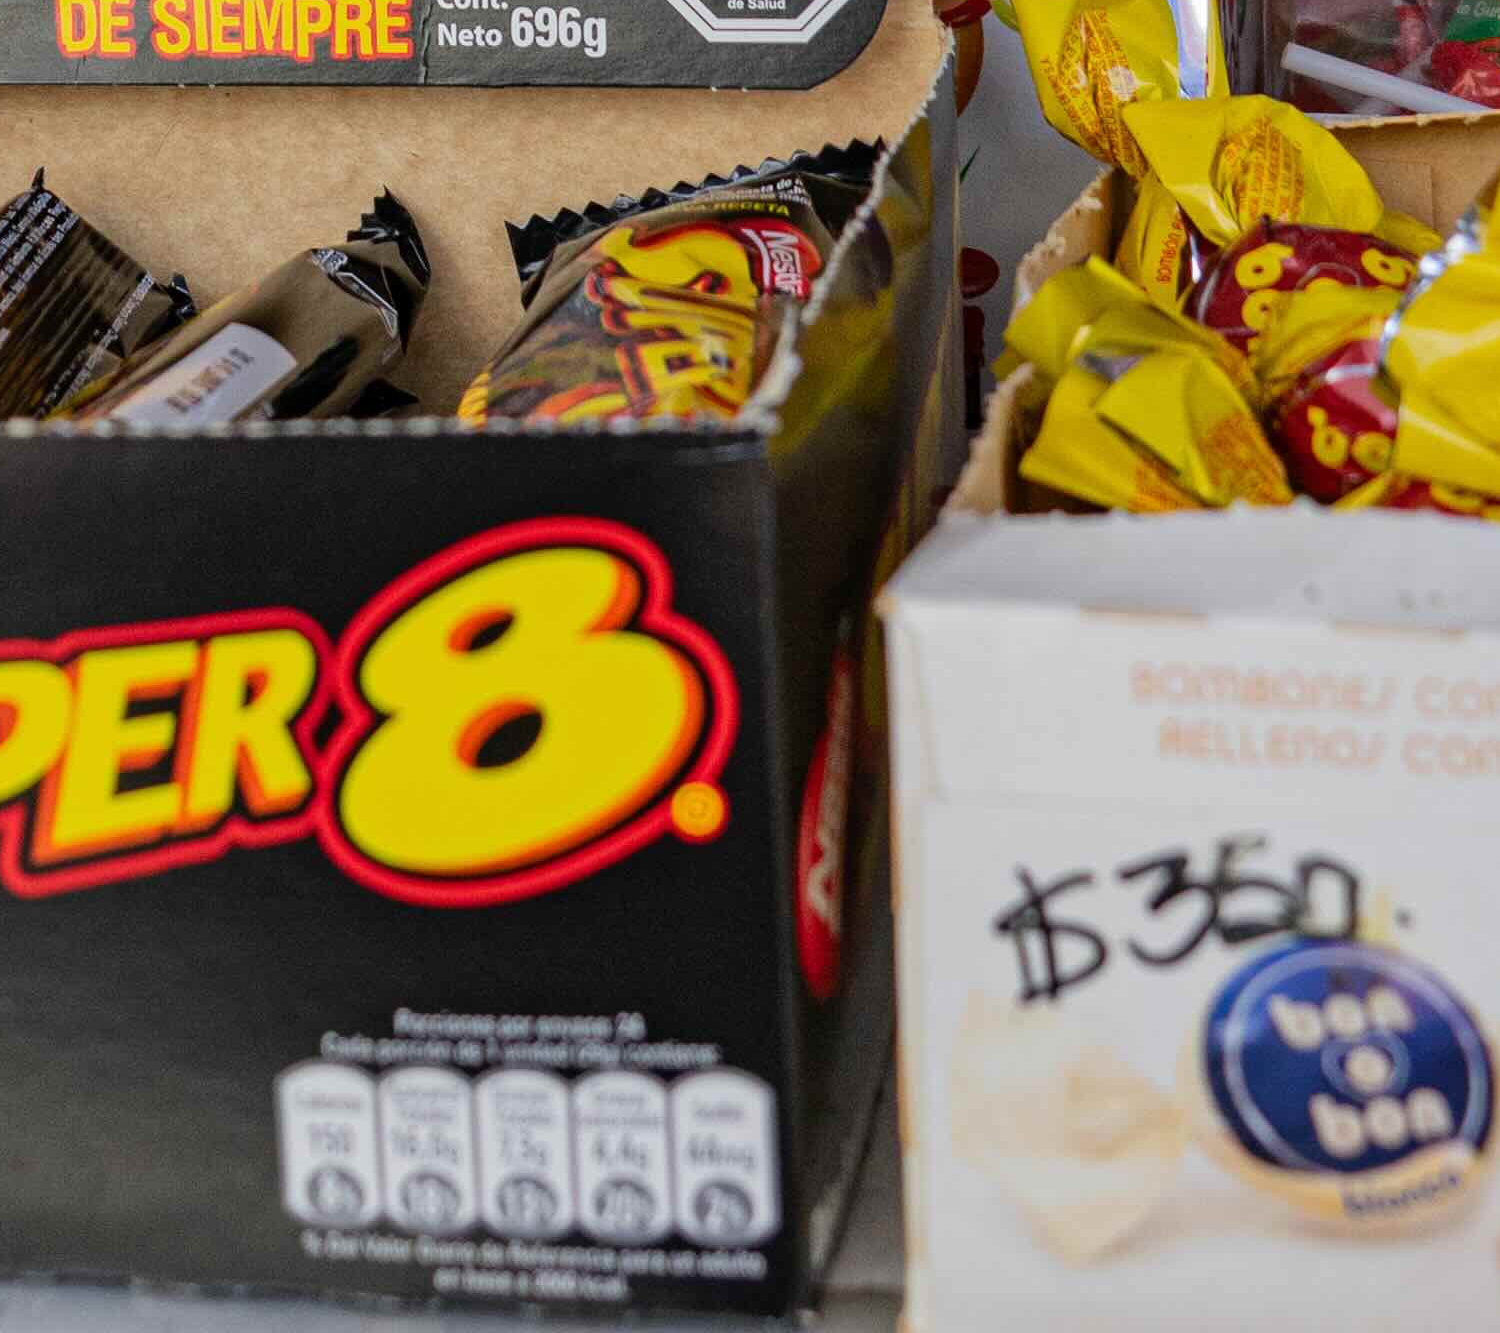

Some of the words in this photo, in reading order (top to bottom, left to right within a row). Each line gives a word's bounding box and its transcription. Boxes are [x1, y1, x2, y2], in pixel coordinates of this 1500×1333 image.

[436, 20, 502, 47] Neto
[510, 5, 609, 57] 696g
[335, 541, 712, 881] 8
[1269, 986, 1416, 1052] bon
[1308, 1085, 1455, 1159] bon
